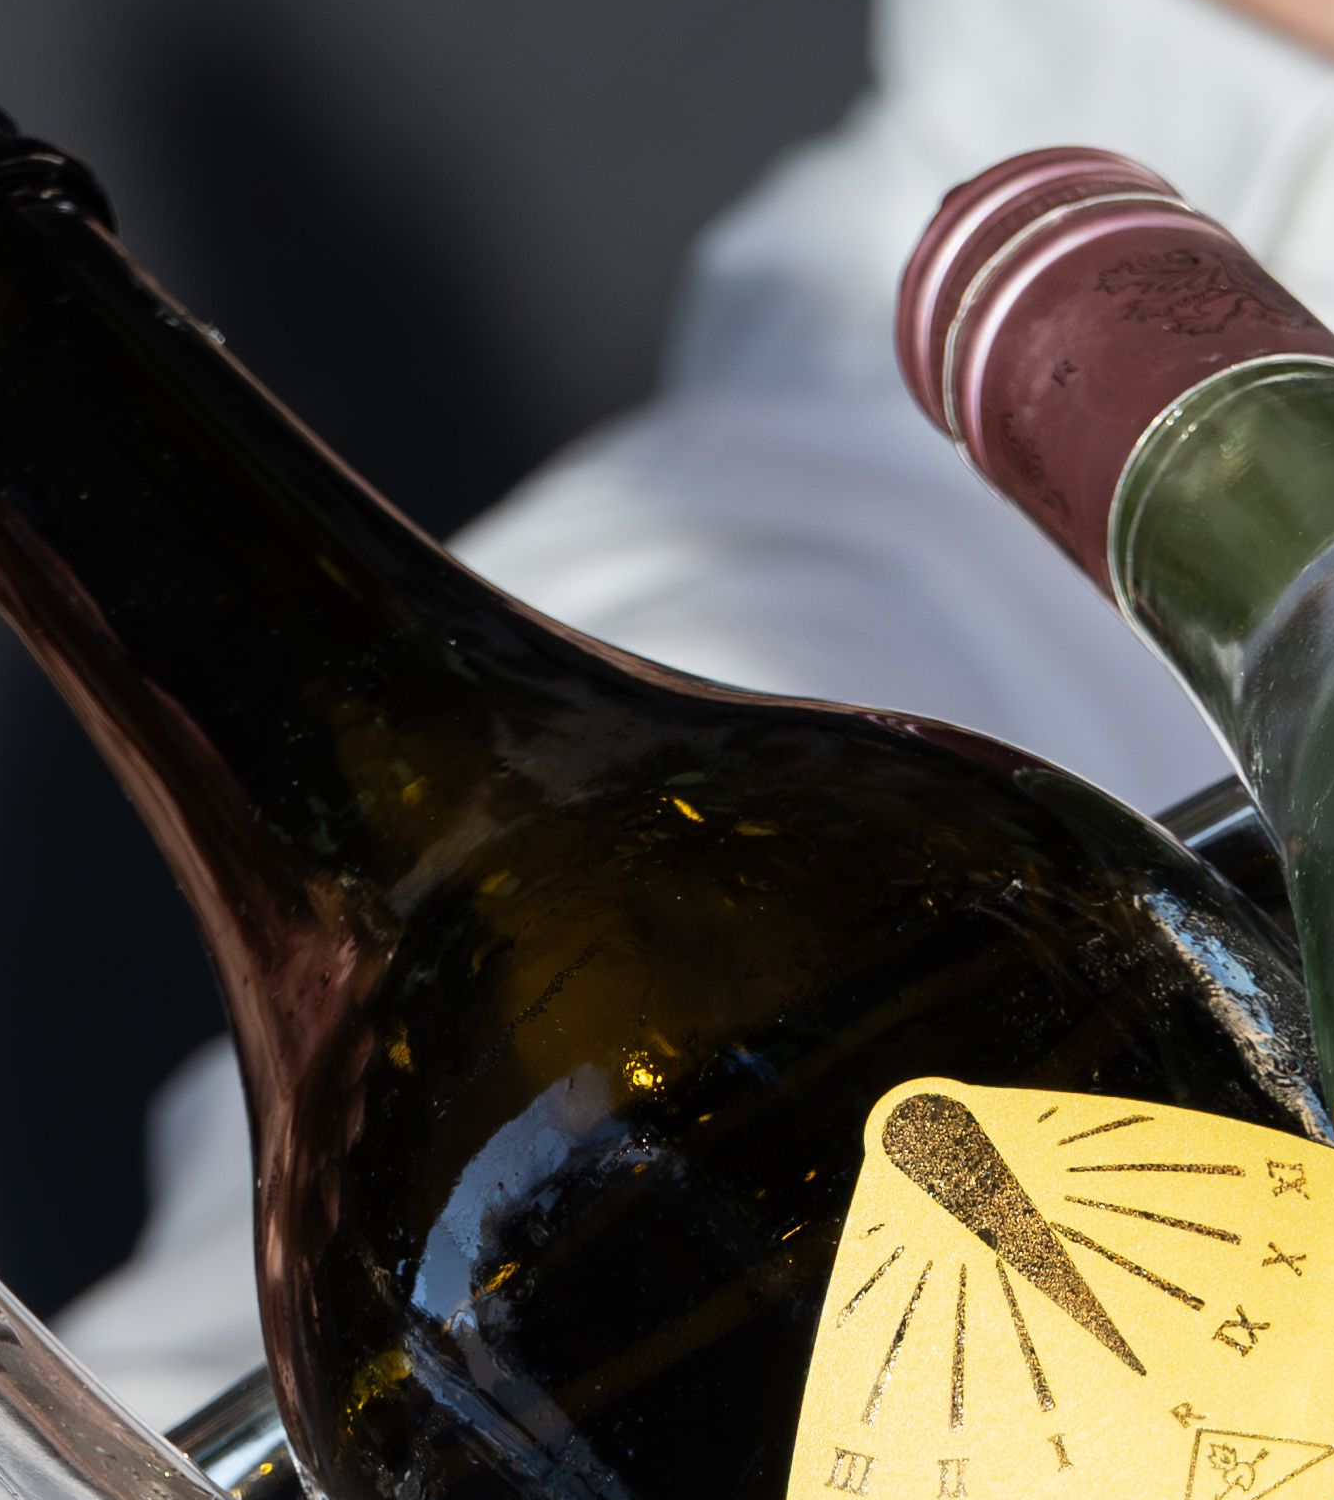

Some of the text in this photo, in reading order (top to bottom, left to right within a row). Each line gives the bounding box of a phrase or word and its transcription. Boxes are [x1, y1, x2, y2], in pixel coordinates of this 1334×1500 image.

[1262, 1241, 1308, 1277] X
[1169, 1401, 1208, 1429] R
[823, 1446, 875, 1497] III
[1047, 1432, 1075, 1472] I
[935, 1457, 970, 1499] II
